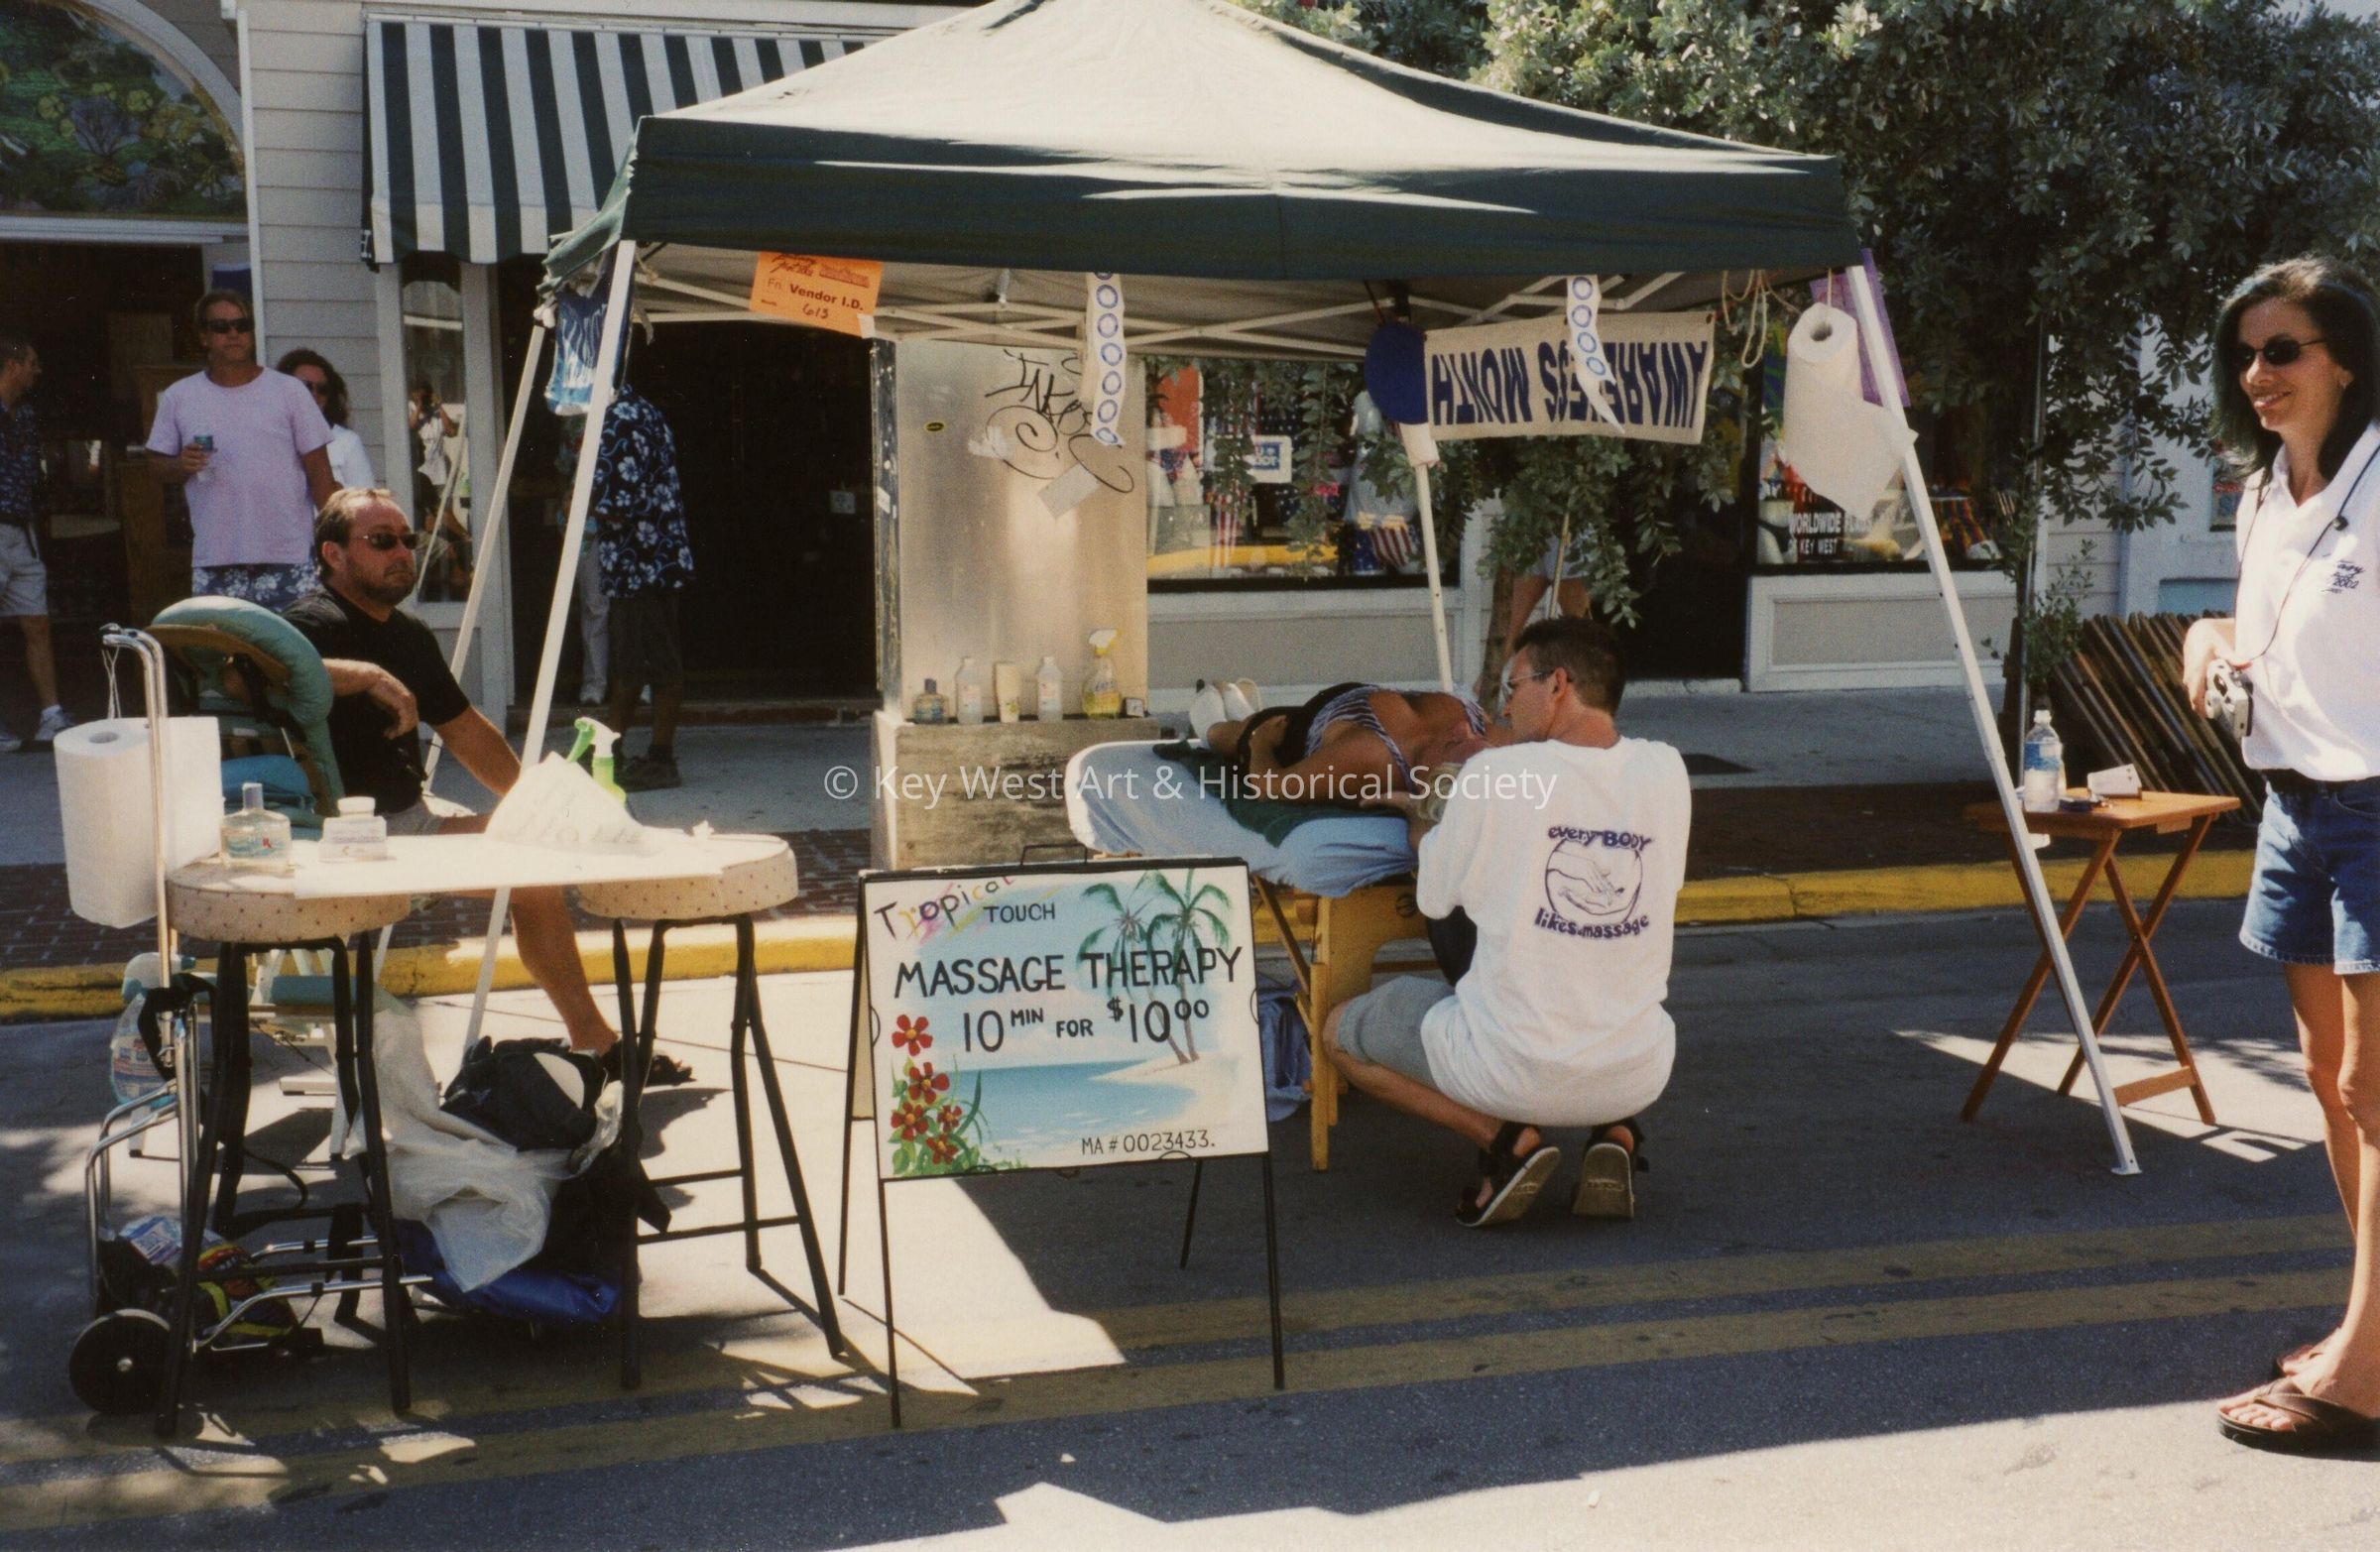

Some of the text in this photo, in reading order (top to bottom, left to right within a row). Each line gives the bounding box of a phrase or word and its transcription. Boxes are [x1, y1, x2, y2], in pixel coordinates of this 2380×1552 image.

[789, 283, 838, 304] Vendor
[841, 296, 864, 311] I.D.
[1431, 339, 1708, 428] AWAREESS MONTH
[1788, 511, 1842, 534] WORLDWIDE
[1799, 537, 1814, 554] KEY
[1817, 537, 1838, 554] WEST
[983, 903, 1055, 923] TOUCH
[1534, 907, 1577, 935] likes
[893, 946, 1243, 999] MASSAGE THERAPY
[963, 1010, 1005, 1052] 10
[1011, 1008, 1044, 1026] MIN
[1056, 1018, 1094, 1038] FOR
